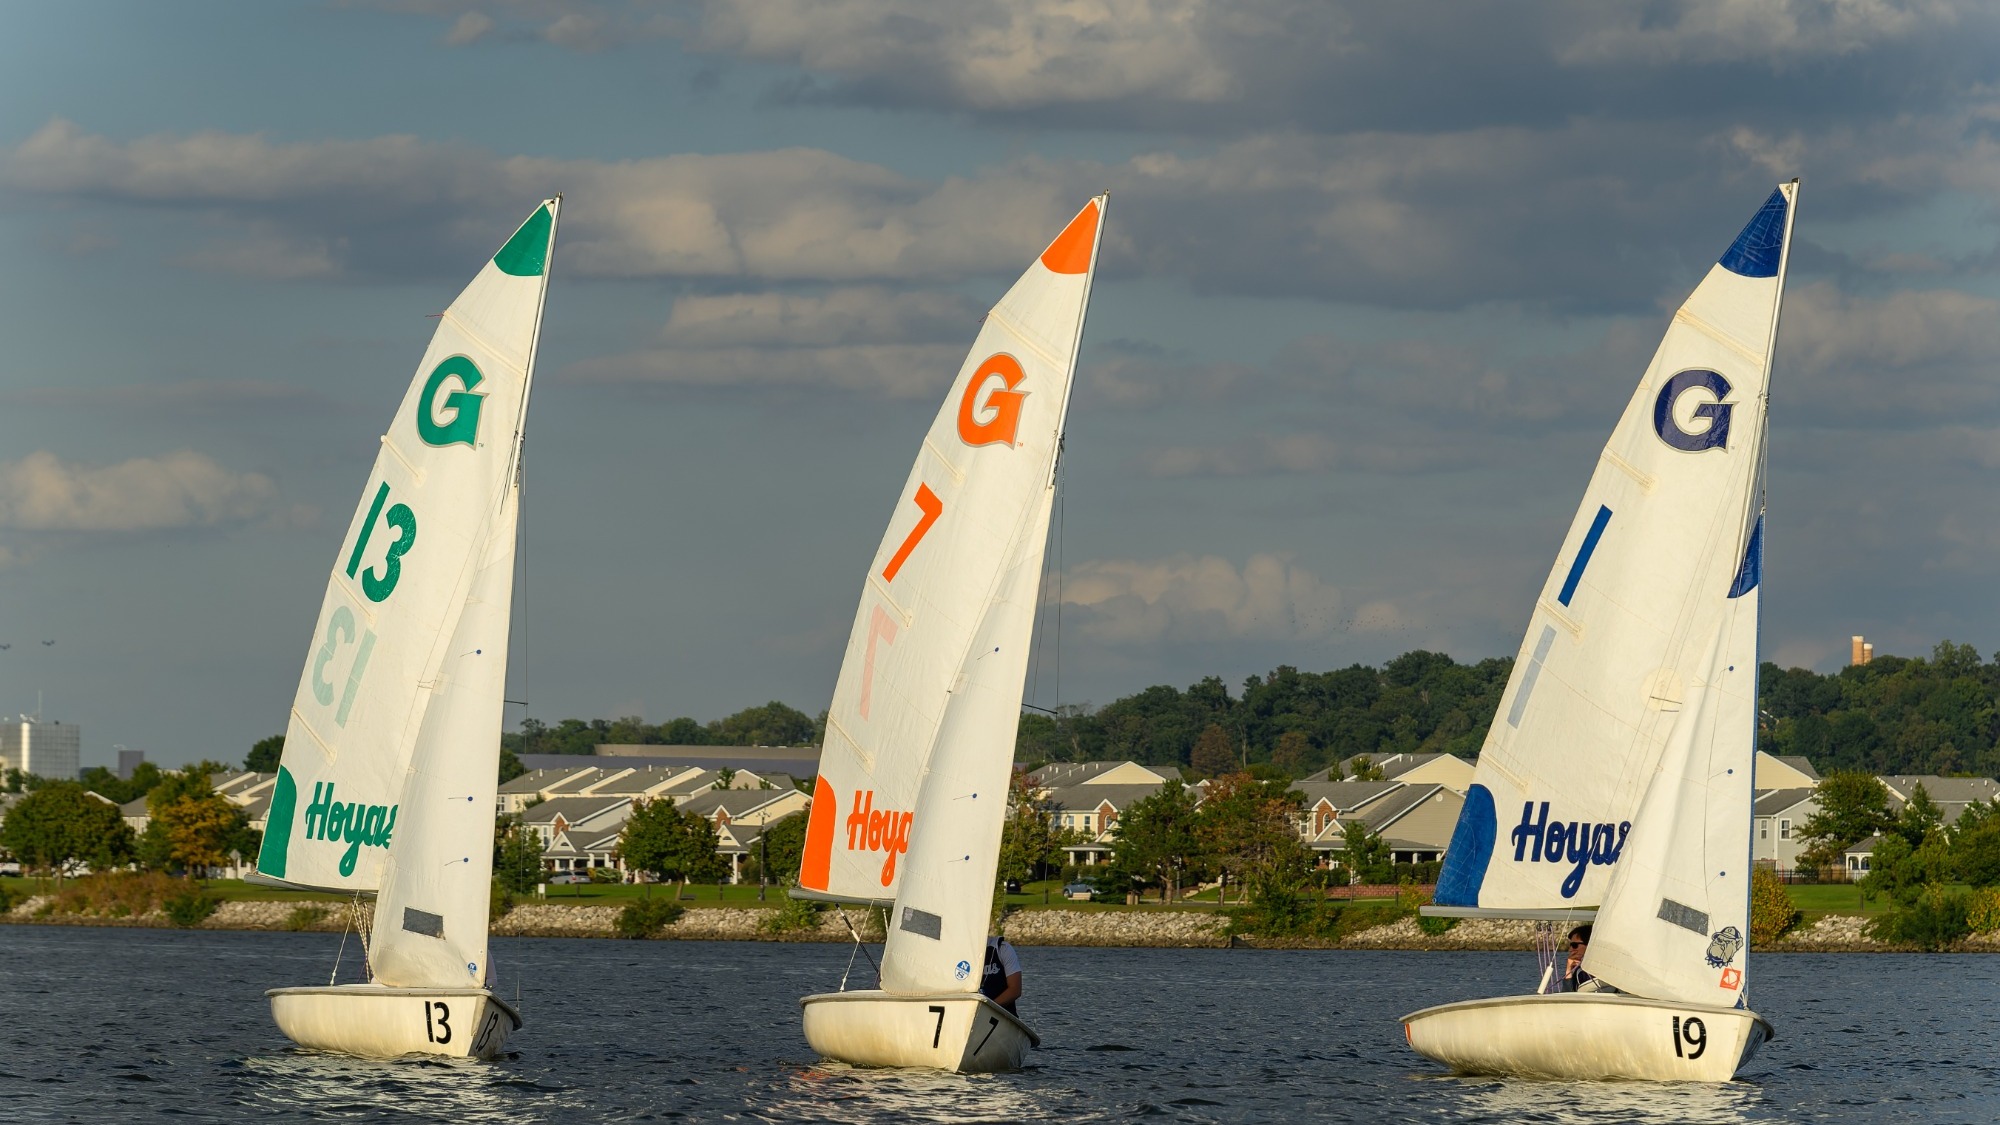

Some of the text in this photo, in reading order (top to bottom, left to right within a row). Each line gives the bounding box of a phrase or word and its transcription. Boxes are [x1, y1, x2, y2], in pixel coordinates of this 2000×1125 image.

[416, 353, 489, 450] G
[957, 351, 1032, 450] G
[1652, 367, 1740, 454] G
[346, 481, 416, 602] 13
[882, 482, 943, 583] 7
[1558, 504, 1613, 607] 1
[847, 790, 914, 887] Hoya
[425, 1001, 452, 1044] 13
[475, 1011, 498, 1052] 13
[929, 1006, 945, 1048] 7
[973, 1017, 999, 1056] 7
[1672, 1015, 1707, 1059] 19
